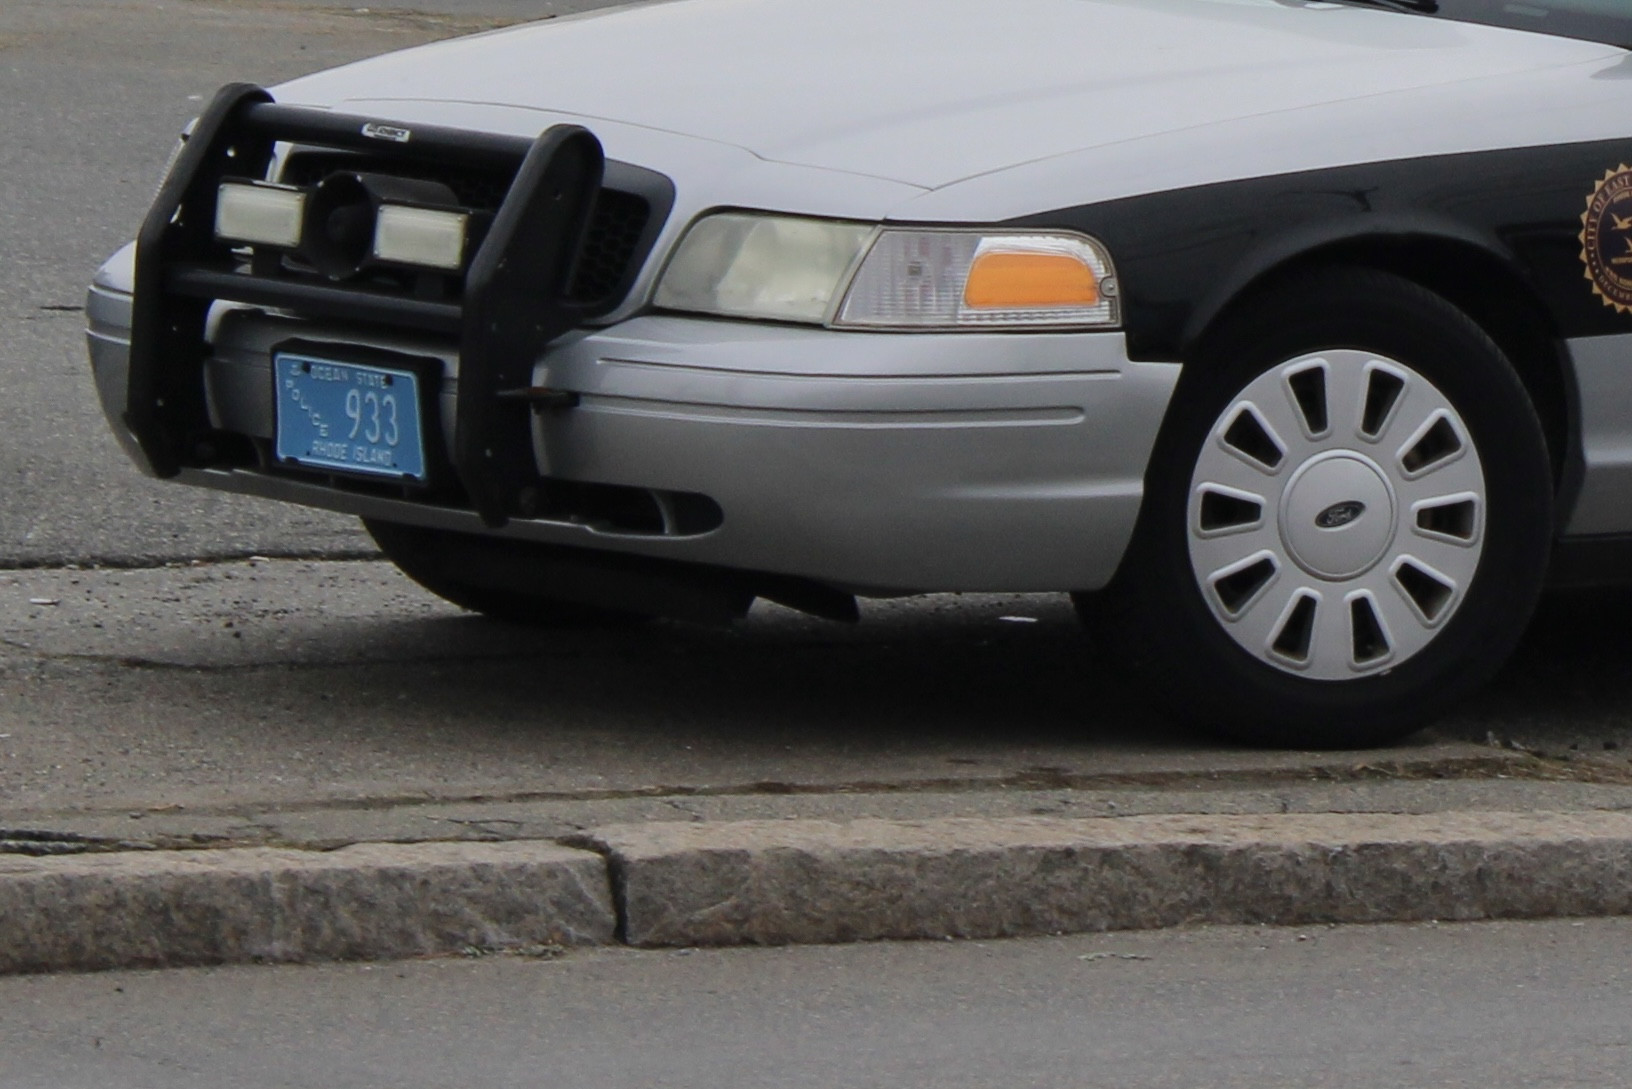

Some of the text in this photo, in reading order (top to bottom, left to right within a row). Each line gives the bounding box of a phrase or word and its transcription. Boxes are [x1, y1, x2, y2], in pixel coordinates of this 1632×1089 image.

[1605, 174, 1631, 194] EAST
[310, 364, 349, 382] OCEAN
[345, 388, 399, 446] 933
[312, 440, 392, 466] RHODE ISLAND
